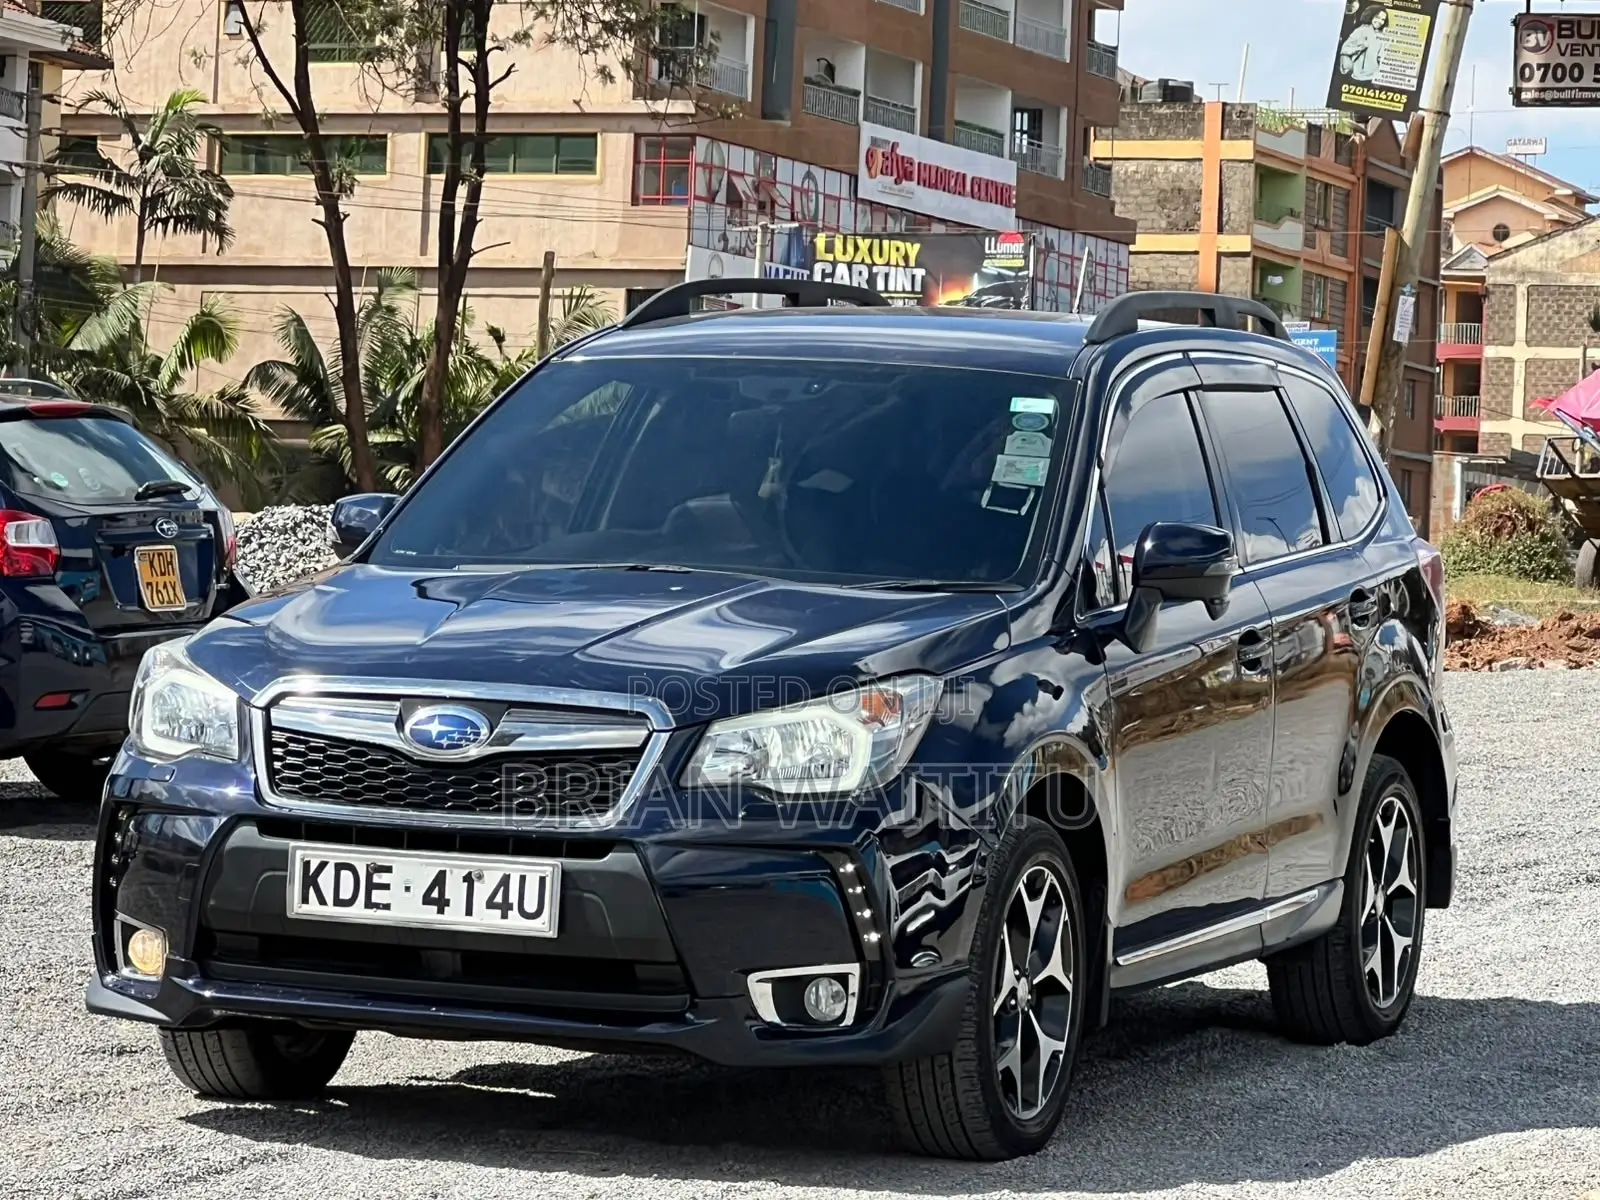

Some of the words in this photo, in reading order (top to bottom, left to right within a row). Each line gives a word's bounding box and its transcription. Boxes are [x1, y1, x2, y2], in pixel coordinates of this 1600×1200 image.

[1557, 20, 1600, 40] BU
[1519, 62, 1585, 84] 0700
[1341, 84, 1408, 103] 0701414705
[916, 161, 970, 198] MEDICAL
[813, 232, 921, 268] LUXURY
[812, 261, 870, 289] CAR
[872, 265, 926, 293] TINT
[148, 551, 175, 577] KDH
[146, 581, 182, 605] 761X
[300, 859, 394, 911] KDE
[421, 868, 548, 921] 414U
